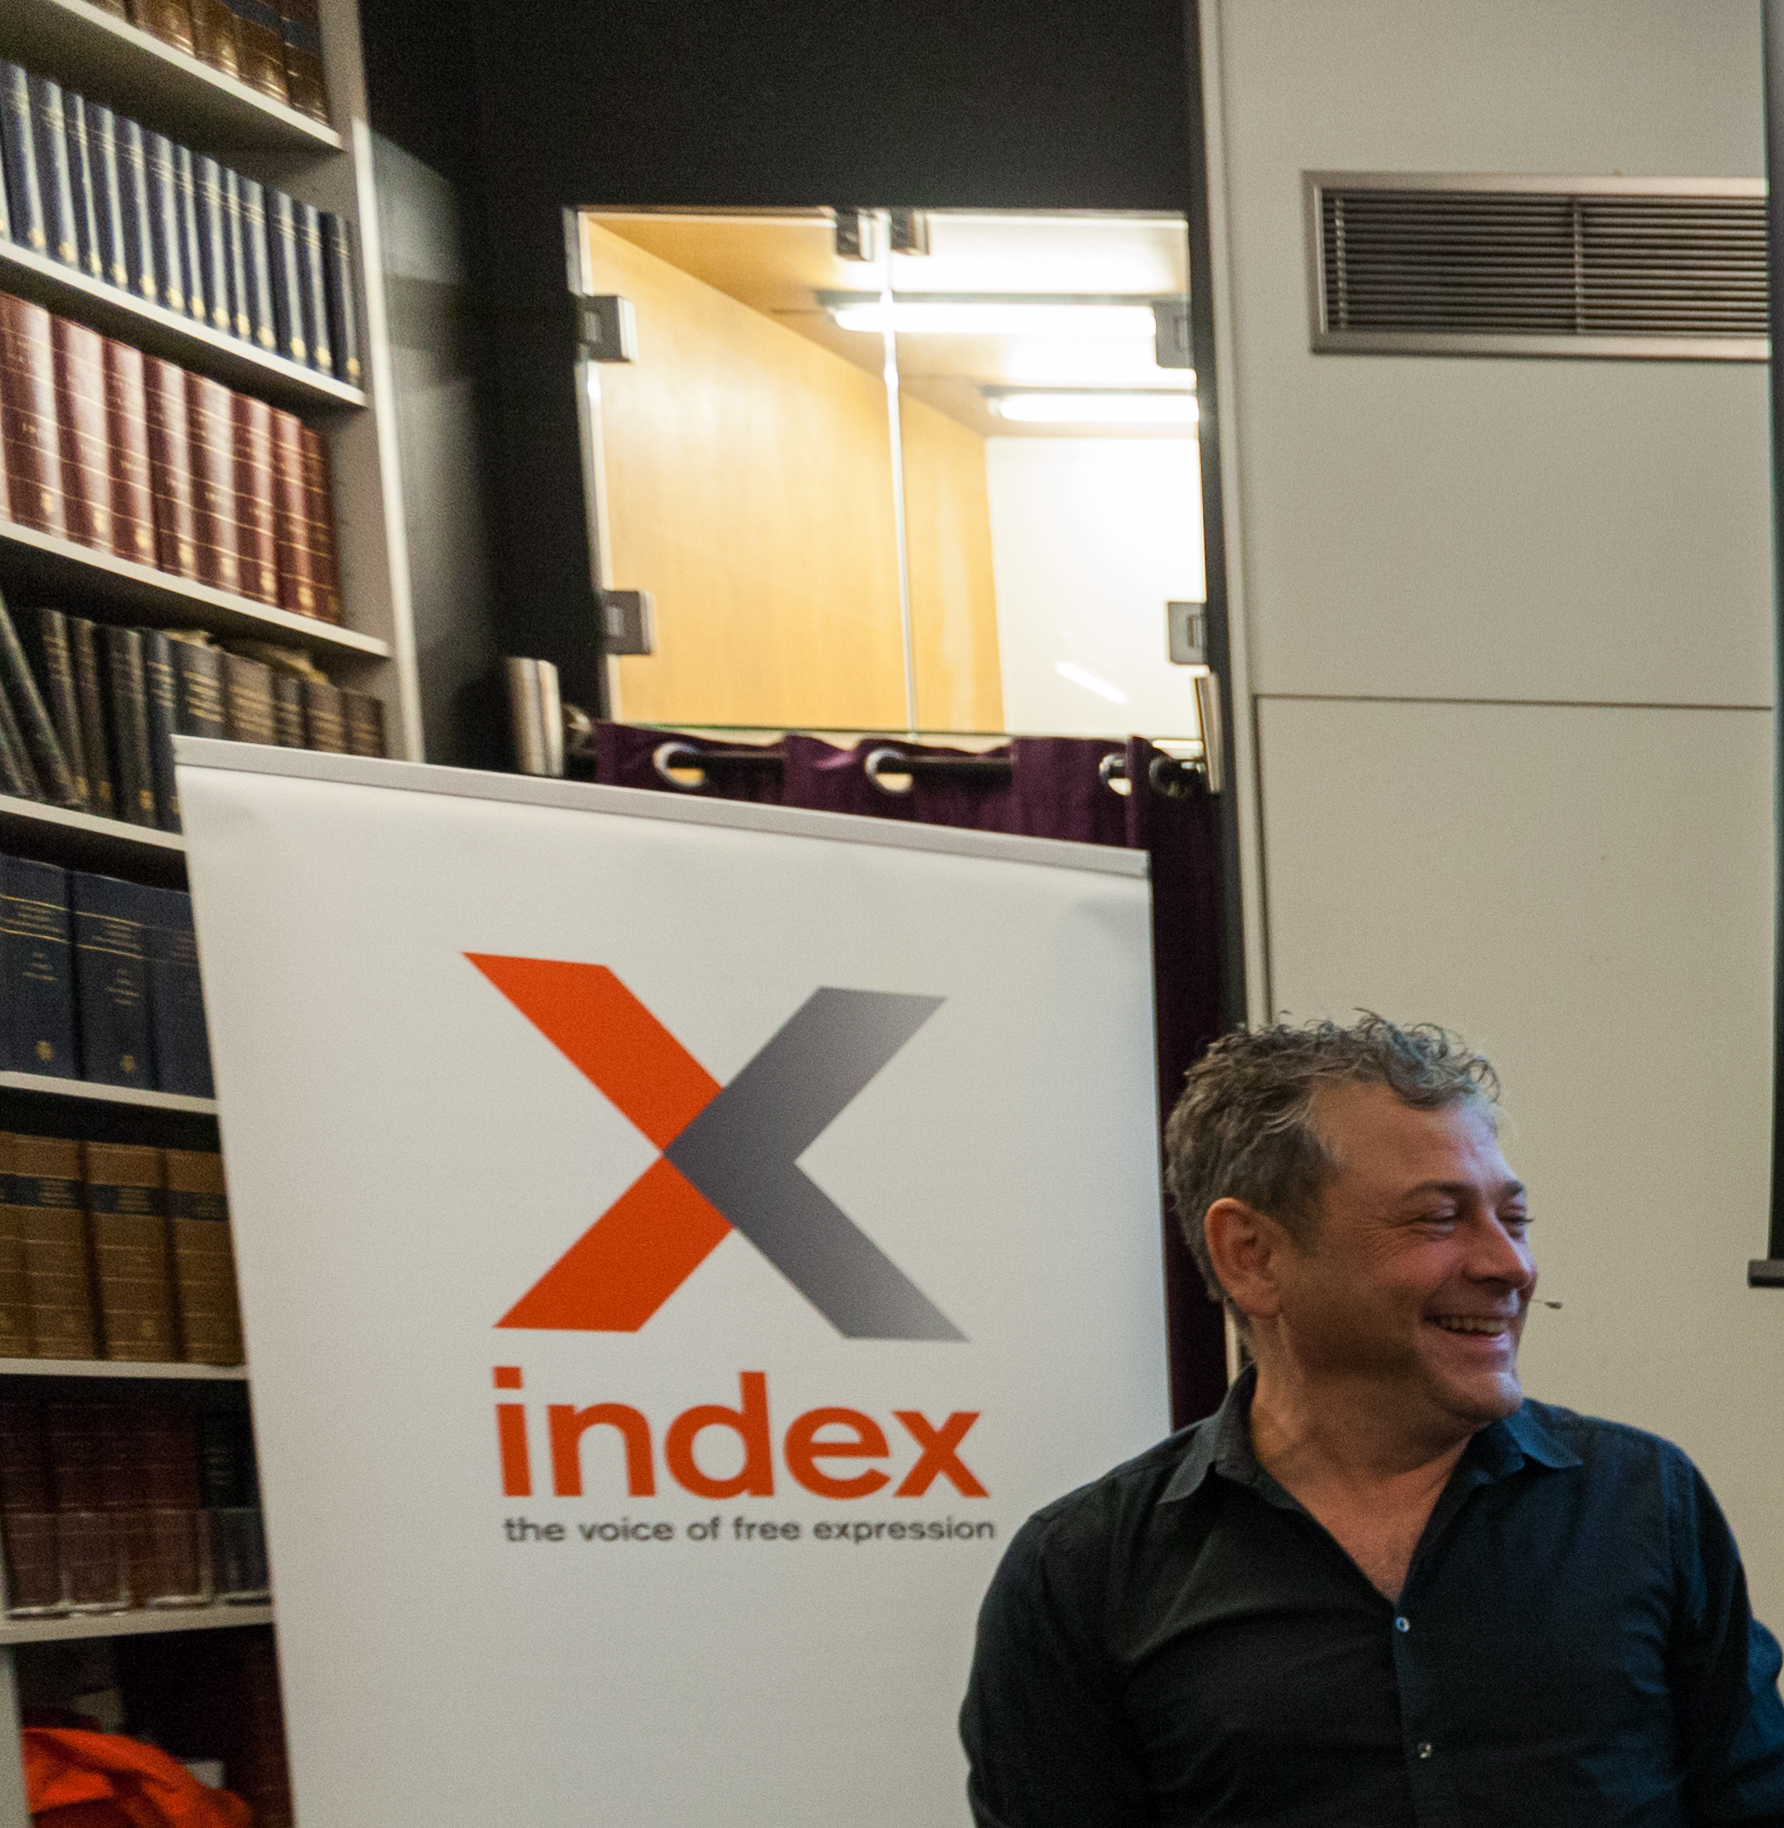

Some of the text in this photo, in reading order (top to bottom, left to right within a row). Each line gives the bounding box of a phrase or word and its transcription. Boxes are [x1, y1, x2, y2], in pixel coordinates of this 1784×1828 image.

[492, 1365, 990, 1500] index
[502, 1514, 997, 1545] the voice of free expression
